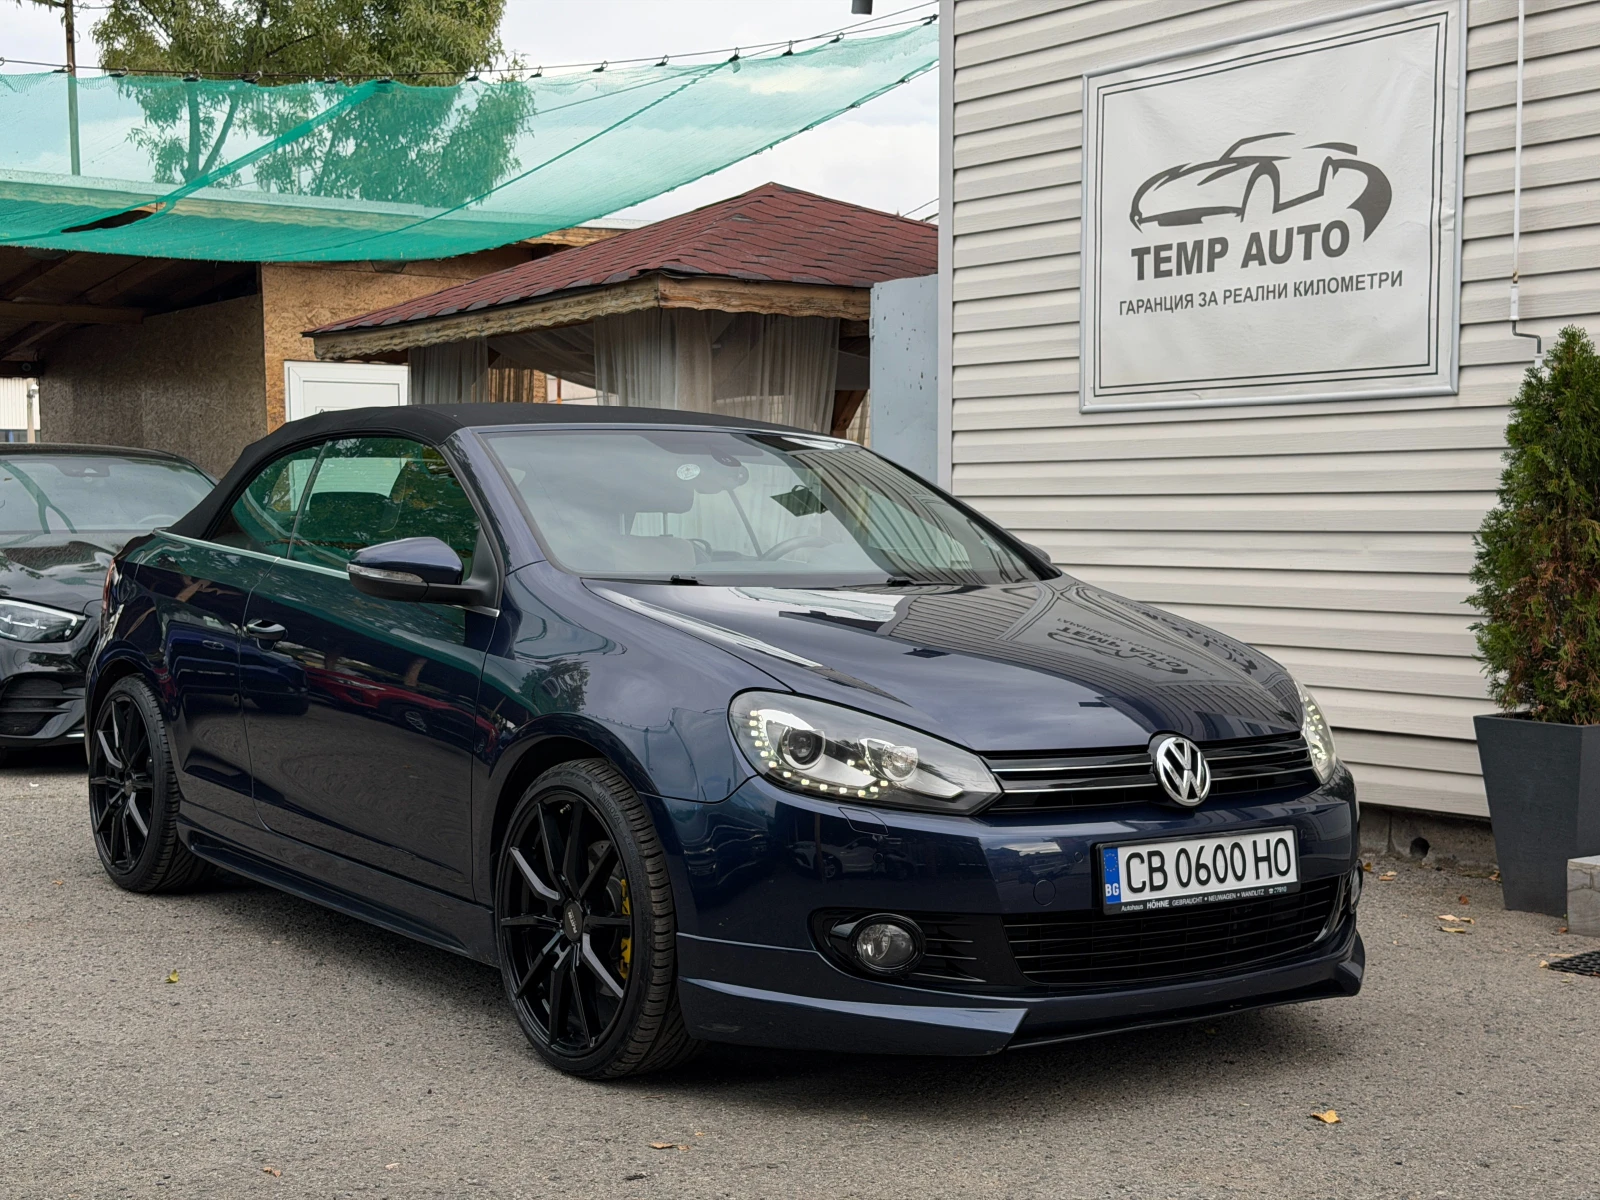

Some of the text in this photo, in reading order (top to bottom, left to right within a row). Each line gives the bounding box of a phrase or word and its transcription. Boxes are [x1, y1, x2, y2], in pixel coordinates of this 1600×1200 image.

[1131, 219, 1350, 281] TEMP AUTO
[1119, 270, 1403, 315] ГАРАНЦИЯ ЗА РЕАЛНИ КИЛОМЕТРИ
[598, 791, 623, 827] UNIROYAL
[1125, 837, 1291, 893] CB 0600 HO
[1105, 883, 1120, 897] BG
[1121, 904, 1144, 912] Autohaus
[1146, 899, 1170, 910] HÖHNE
[1171, 896, 1203, 907] GEBRAUCHT
[1208, 892, 1236, 902] NEUWAGEN
